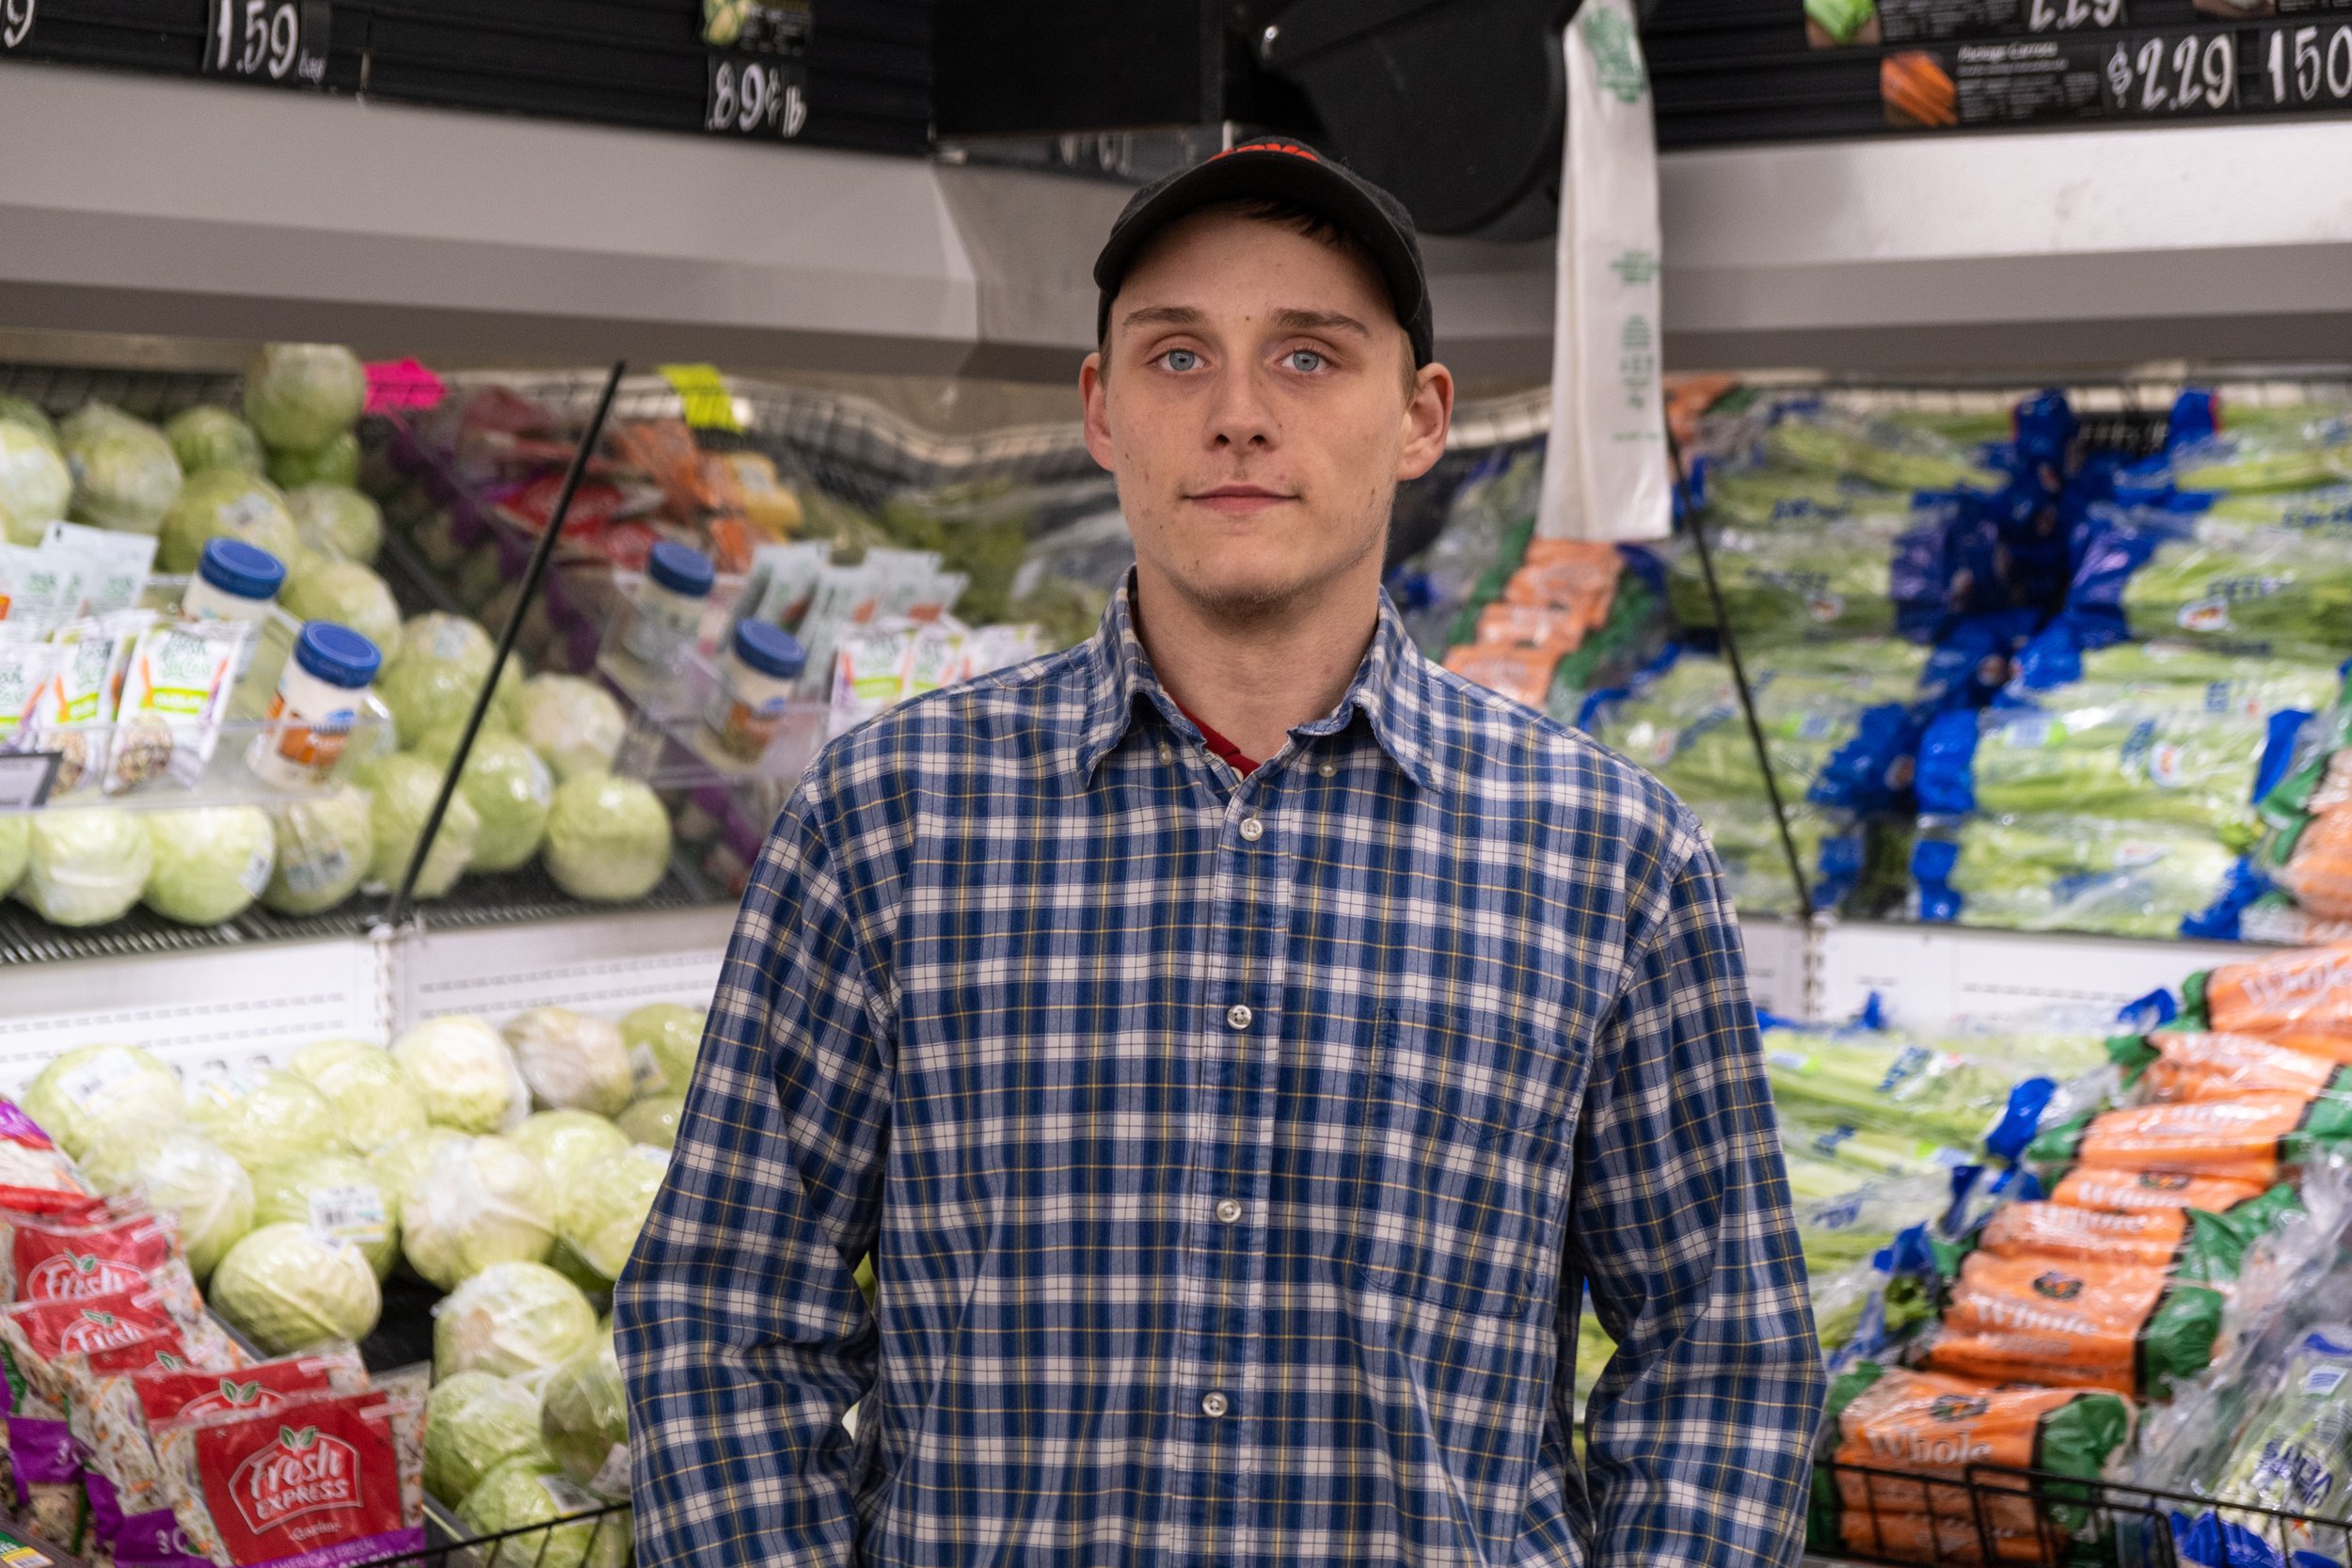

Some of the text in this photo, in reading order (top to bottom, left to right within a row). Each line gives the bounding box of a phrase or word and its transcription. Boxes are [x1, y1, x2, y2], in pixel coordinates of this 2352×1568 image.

[2106, 33, 2233, 112] $2.29
[247, 1439, 344, 1501] Fresh
[1866, 1422, 1993, 1465] Whole
[254, 1478, 351, 1522] EXPRESS
